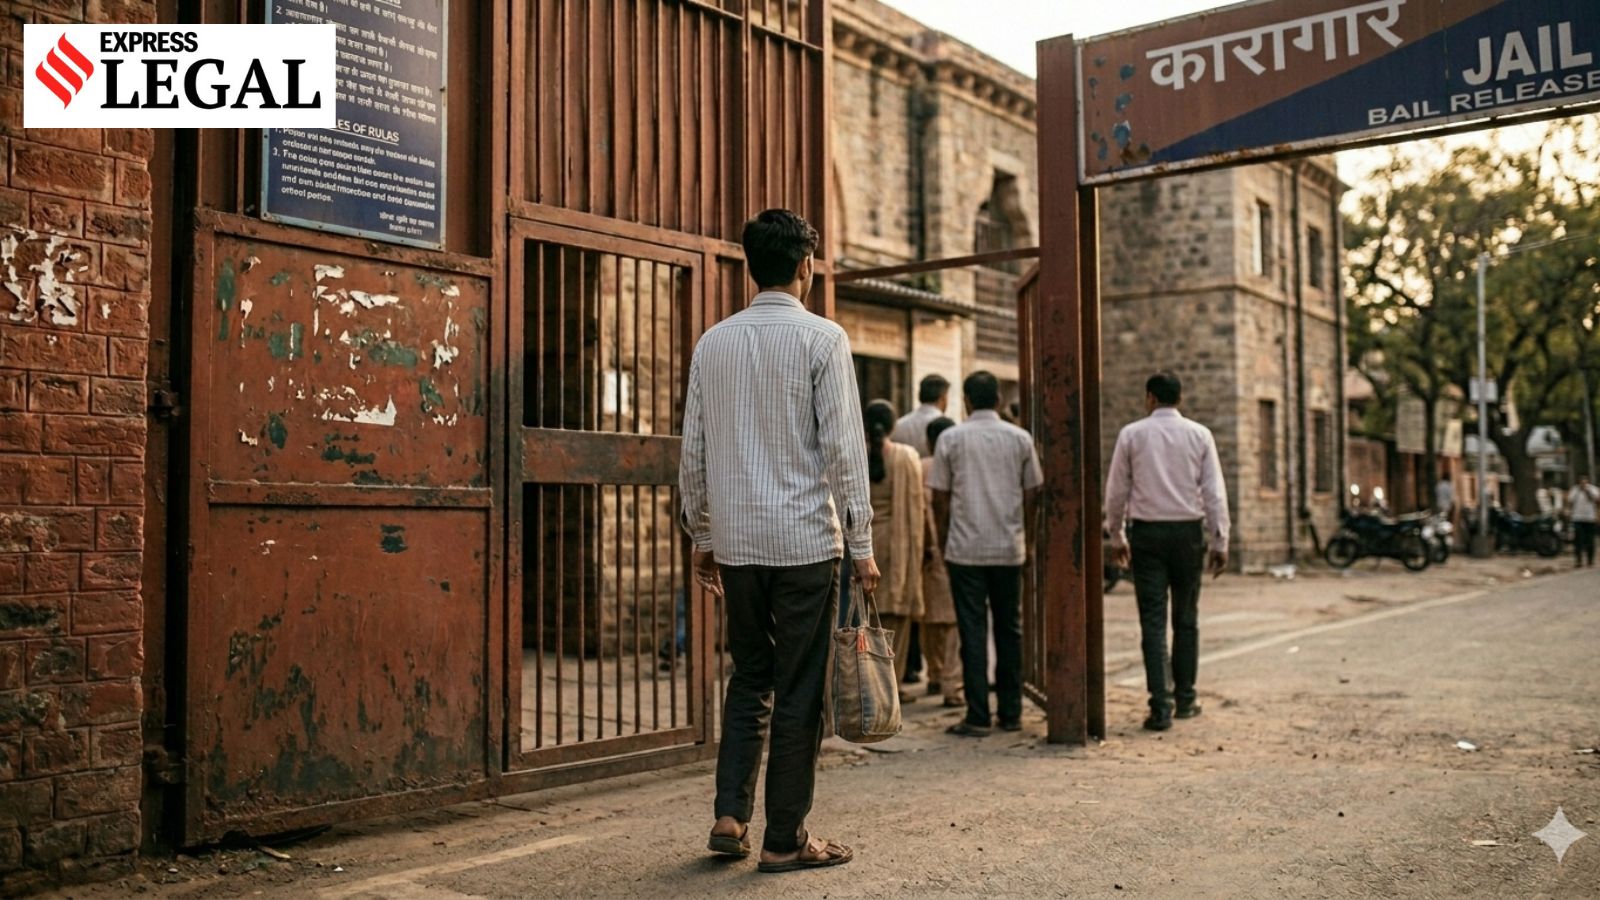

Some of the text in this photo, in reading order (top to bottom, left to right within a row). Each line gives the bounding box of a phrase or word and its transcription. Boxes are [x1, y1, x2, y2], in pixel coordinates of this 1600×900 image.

[1146, 0, 1405, 90] कारागार
[1462, 21, 1592, 85] JAIL
[1368, 69, 1600, 126] BAIL RELEASE
[336, 119, 400, 142] ES OF RULAS
